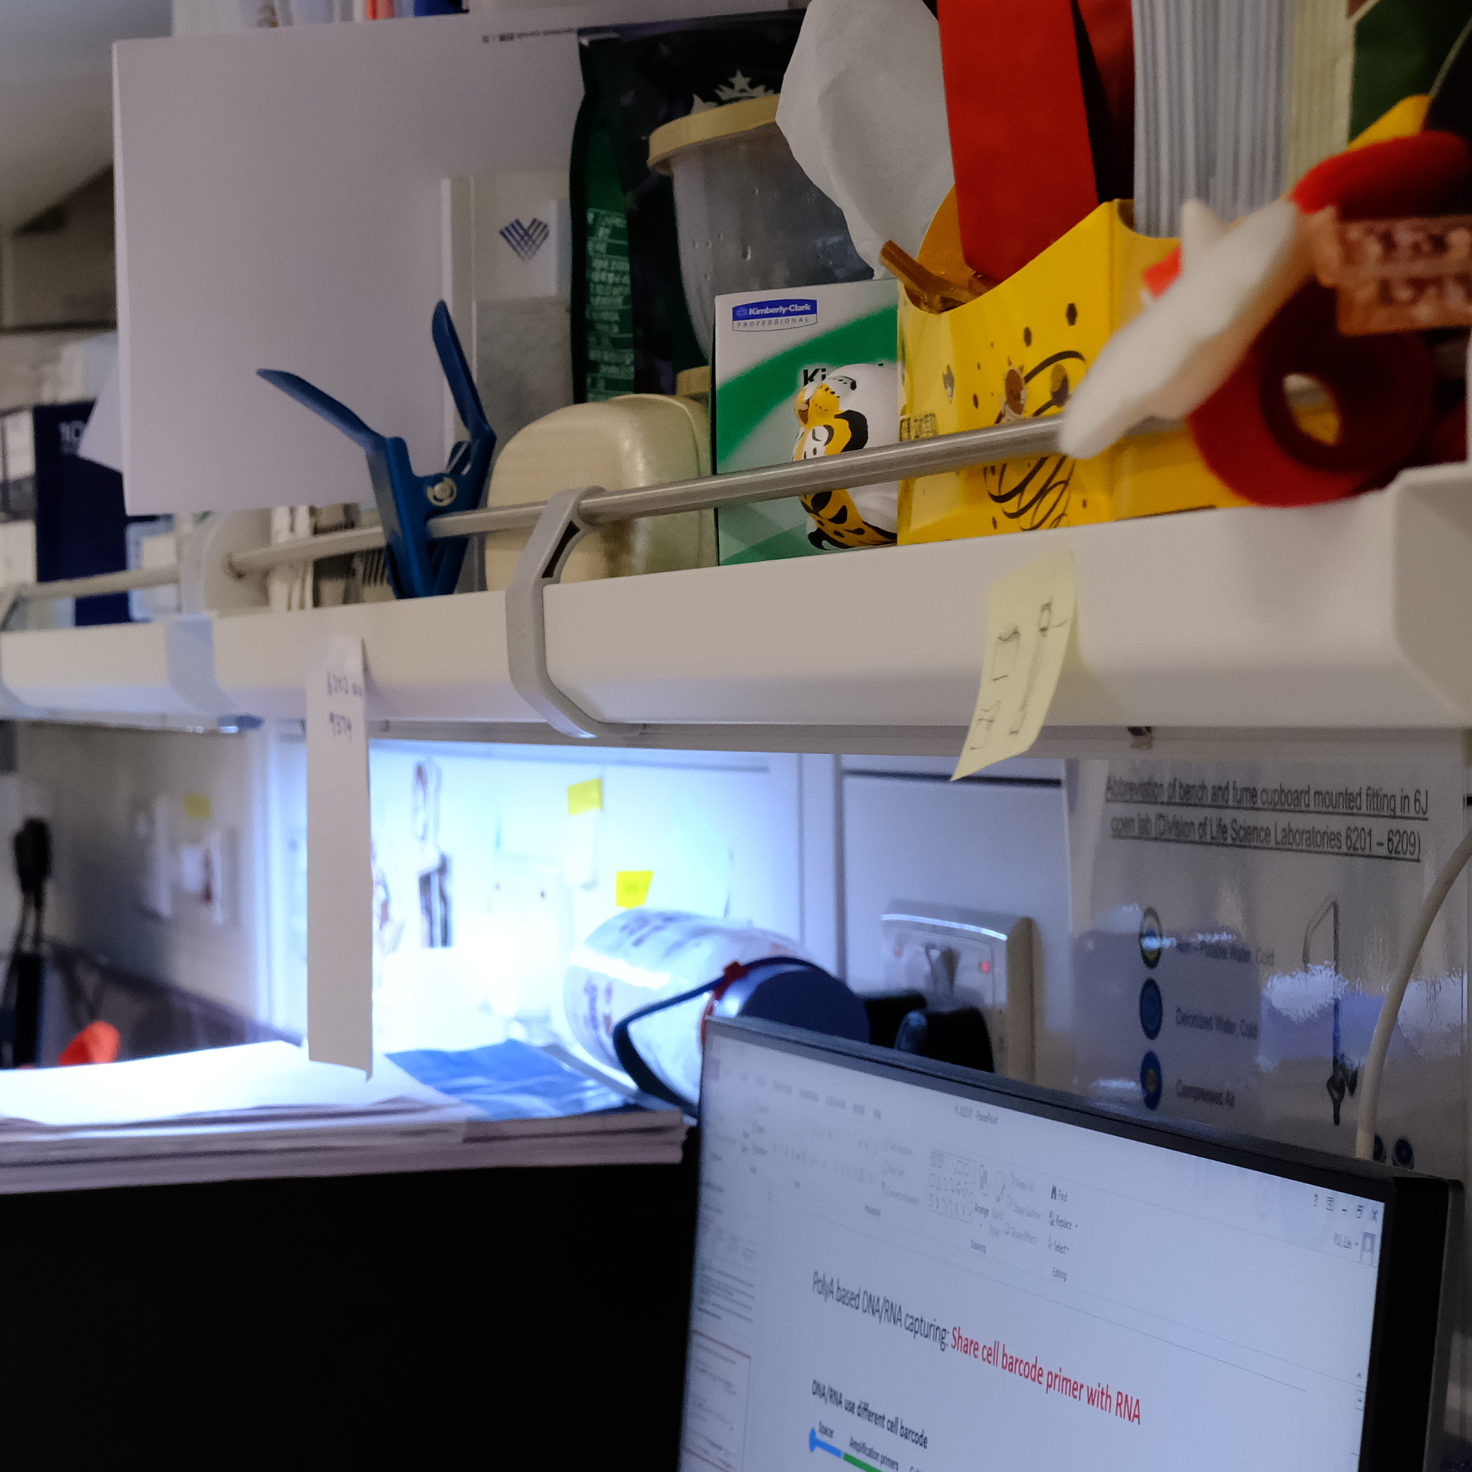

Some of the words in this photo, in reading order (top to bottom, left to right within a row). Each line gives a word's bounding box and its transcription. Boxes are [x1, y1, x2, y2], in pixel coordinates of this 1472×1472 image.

[737, 317, 810, 328] PROFESSIONAL
[749, 303, 811, 316] Kimberly-Clark
[1211, 780, 1229, 803] and
[1232, 780, 1257, 805] fume
[1260, 781, 1310, 809] cupboard
[1314, 785, 1362, 810] mounted
[1366, 785, 1396, 815] fitting
[1400, 788, 1410, 814] in
[1414, 789, 1429, 815] 6J
[1198, 816, 1208, 840] of
[1210, 817, 1228, 841] Life
[1230, 818, 1271, 843] Science
[1275, 822, 1342, 850] Laboratories
[1345, 826, 1372, 853] 6201
[1387, 829, 1421, 860] 6209)
[812, 1270, 835, 1303] PolyA
[835, 1278, 860, 1311] based
[861, 1289, 903, 1329] DNA/RNA
[904, 1310, 950, 1352] capturing:
[951, 1326, 979, 1360] Share
[981, 1339, 1000, 1368] cell
[1001, 1343, 1044, 1386] barcode
[1046, 1367, 1084, 1403] primer
[1086, 1381, 1113, 1415] with
[1116, 1389, 1142, 1425] RNA
[811, 1378, 843, 1409] DNA/RNA
[844, 1398, 856, 1415] use
[857, 1399, 885, 1430] different
[886, 1415, 899, 1436] cell
[899, 1417, 928, 1449] barcode
